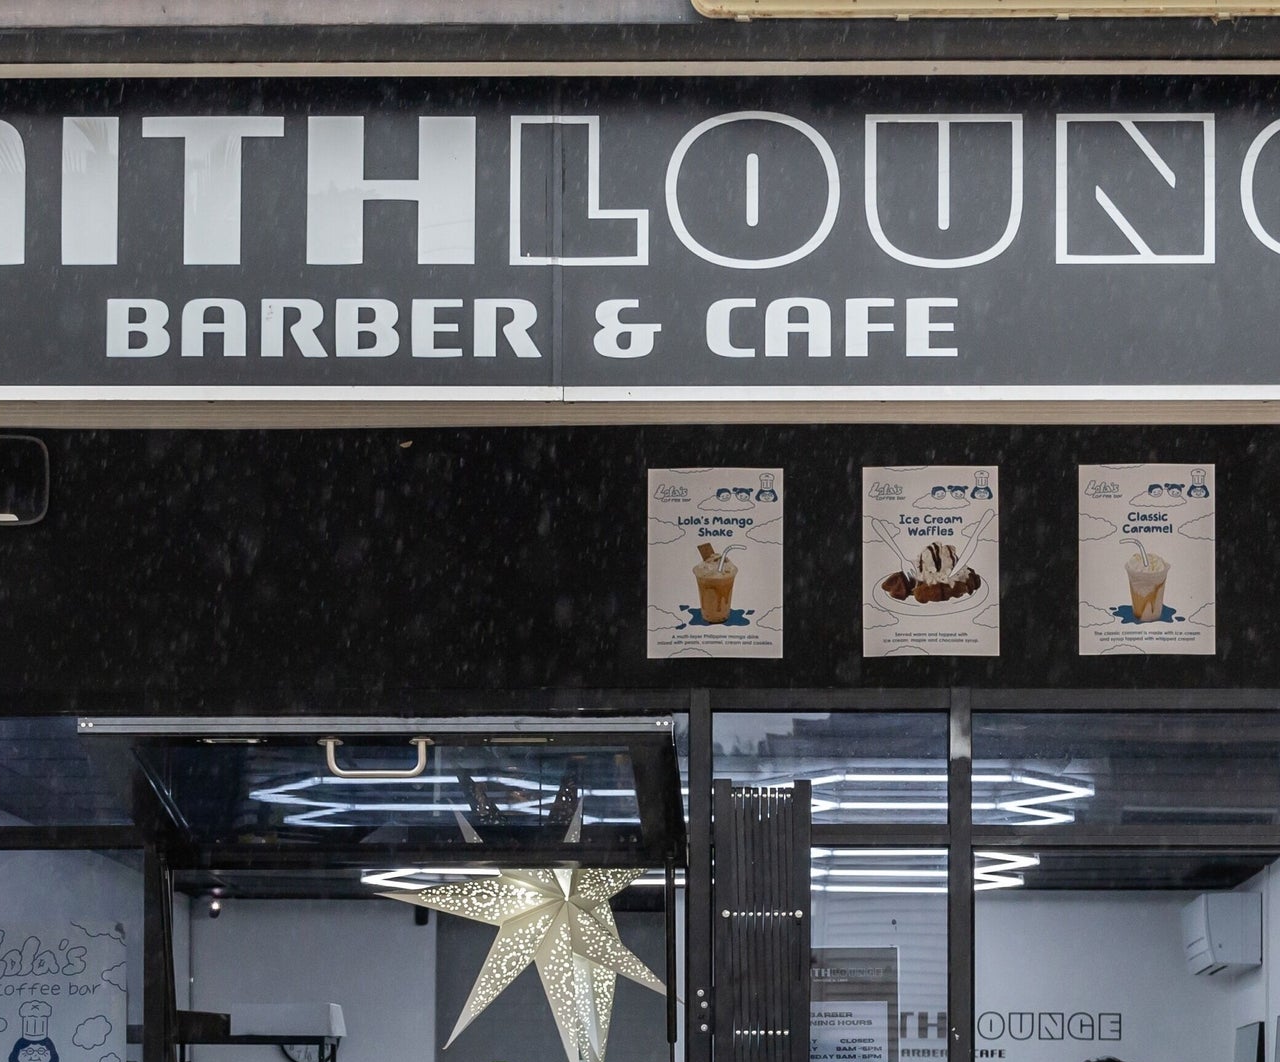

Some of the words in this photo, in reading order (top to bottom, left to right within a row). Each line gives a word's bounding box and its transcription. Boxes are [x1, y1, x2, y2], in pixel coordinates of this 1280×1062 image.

[106, 297, 542, 359] BARBER
[592, 297, 662, 360] &
[704, 296, 959, 359] CAFE
[677, 516, 710, 526] Lola's
[712, 516, 754, 528] Mango
[898, 514, 920, 525] Ice
[923, 514, 963, 525] Cream
[1127, 511, 1168, 522] Classic
[697, 527, 734, 537] Shake
[907, 526, 954, 537] Waffles
[1122, 523, 1173, 534] Caramel
[69, 982, 102, 996] bar
[837, 1019, 873, 1027] HOURS
